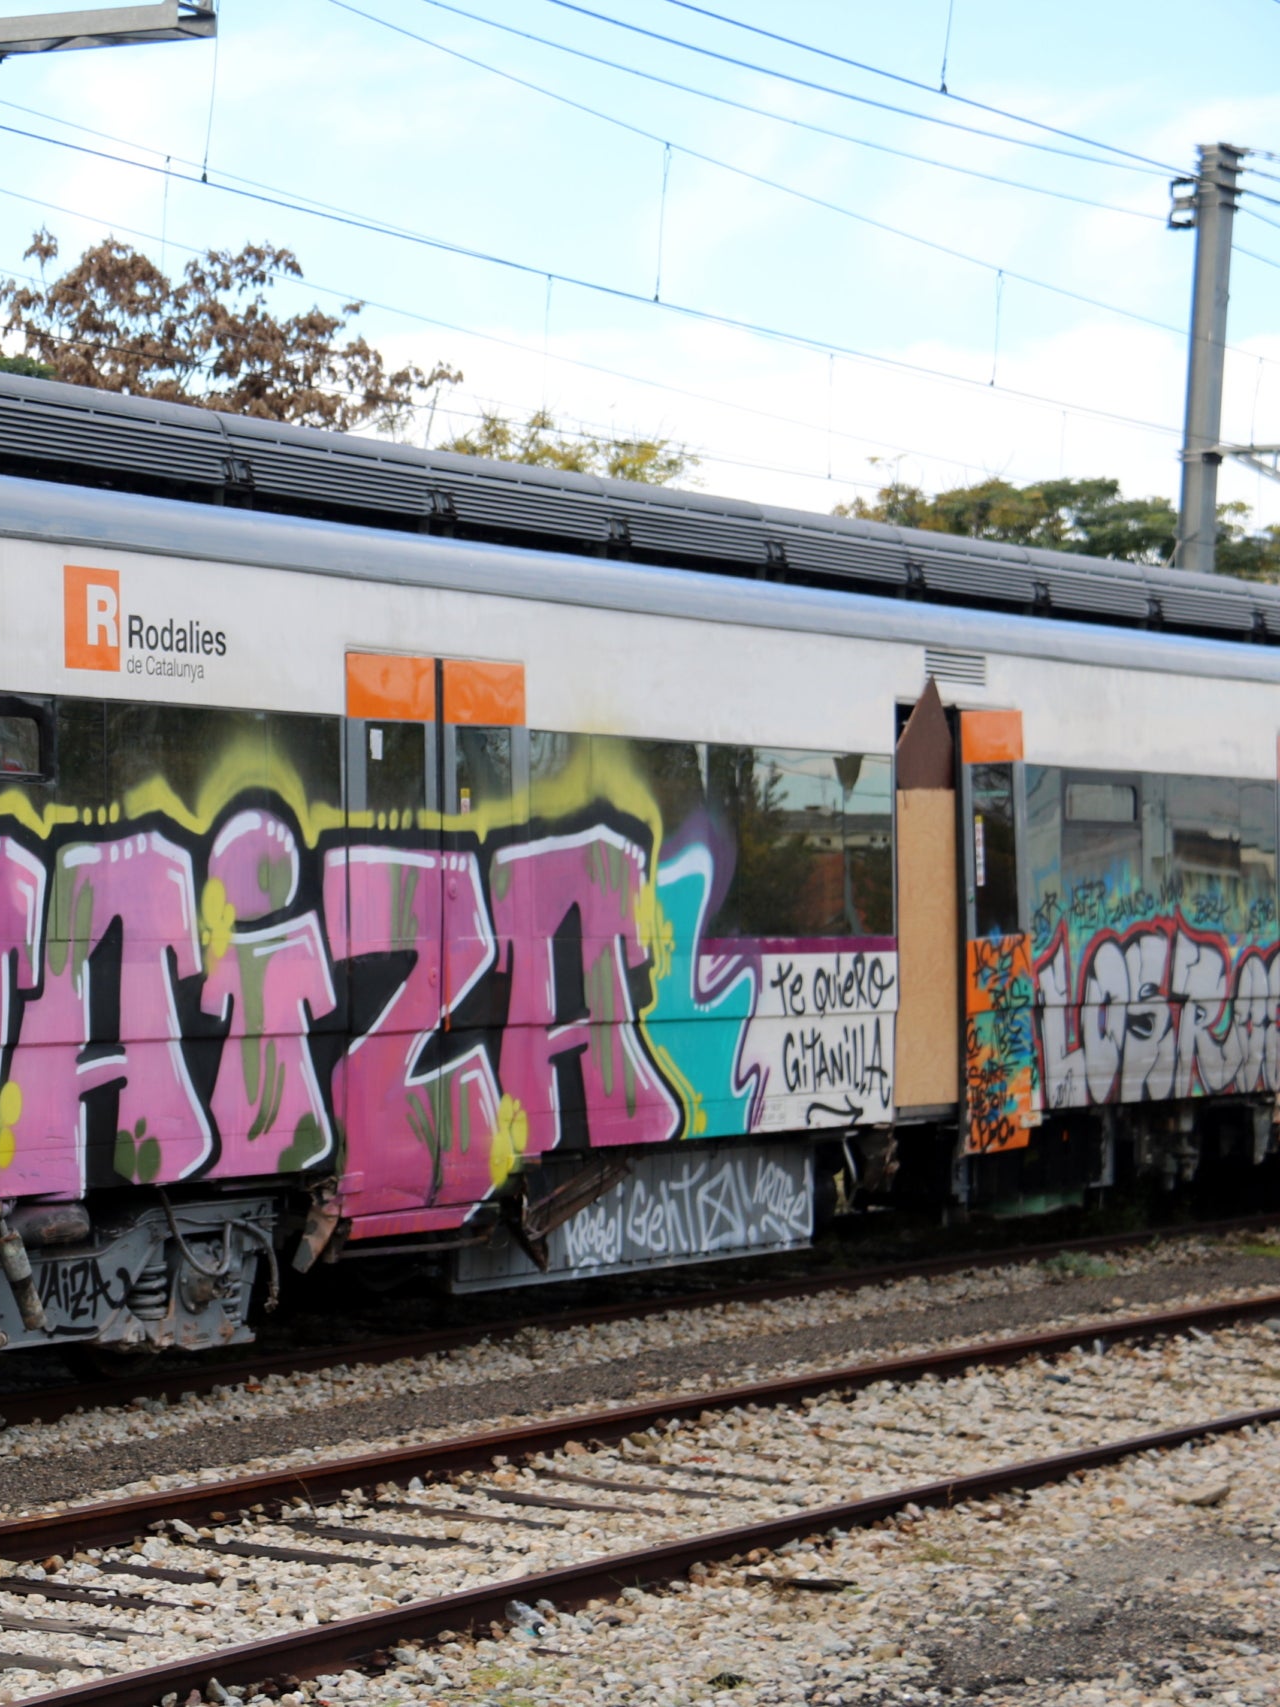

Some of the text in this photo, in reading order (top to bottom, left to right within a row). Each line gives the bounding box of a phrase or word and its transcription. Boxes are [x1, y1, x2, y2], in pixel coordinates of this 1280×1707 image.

[127, 613, 228, 657] Rodalies
[126, 654, 205, 684] de Catalunya
